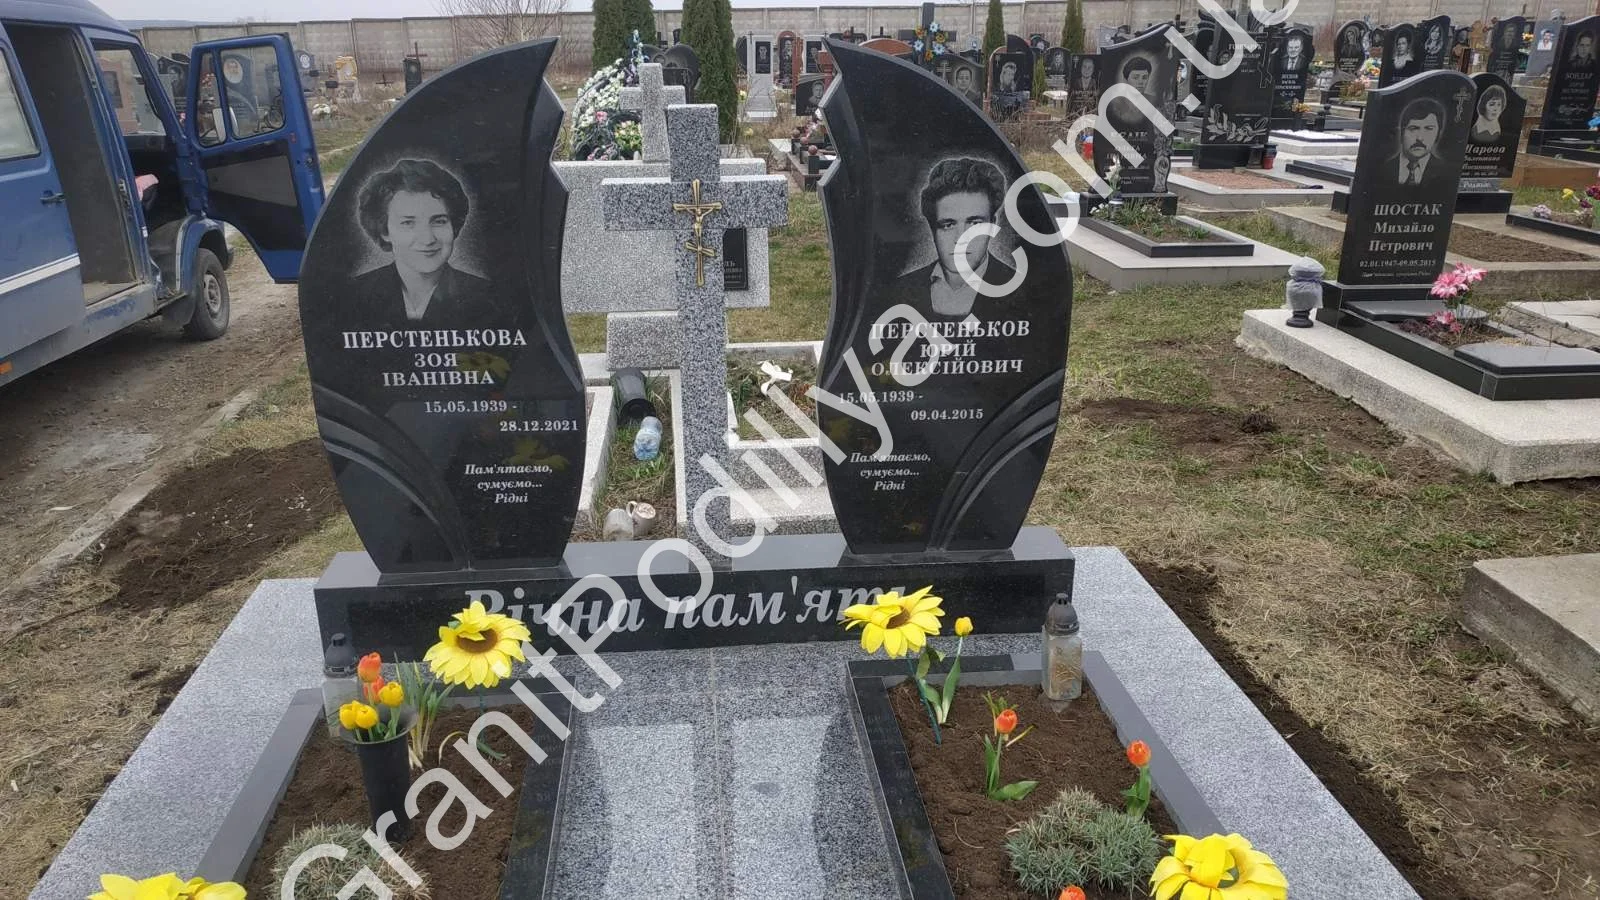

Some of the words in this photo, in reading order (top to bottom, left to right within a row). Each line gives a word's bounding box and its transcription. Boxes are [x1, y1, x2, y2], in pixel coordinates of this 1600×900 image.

[1374, 203, 1442, 216] ШОСТАК
[1374, 222, 1435, 233] Михайло
[1369, 240, 1433, 254] Петрович
[870, 320, 1030, 340] ПЕРСТЕНЬКОВ
[342, 328, 527, 349] ПЕРСТЕНЬКОВА
[920, 340, 976, 358] ЮРІЙ
[414, 353, 458, 368] ЗОЯ
[871, 357, 1023, 376] ОЛЕКСІЙОВИЧ
[382, 370, 495, 387] ІВАНІВНА
[839, 390, 914, 404] 15.05.1939
[424, 400, 508, 413] 15.05.1939
[910, 408, 984, 421] 09.04.2015
[499, 420, 579, 432] 28.12.2021
[464, 463, 553, 475] Пам'ятаємо,
[860, 468, 920, 479] сумуємо...
[477, 478, 543, 490] сумуємо...
[874, 480, 906, 491] Рідні
[494, 493, 529, 504] Рідні
[664, 575, 906, 630] пам'ят
